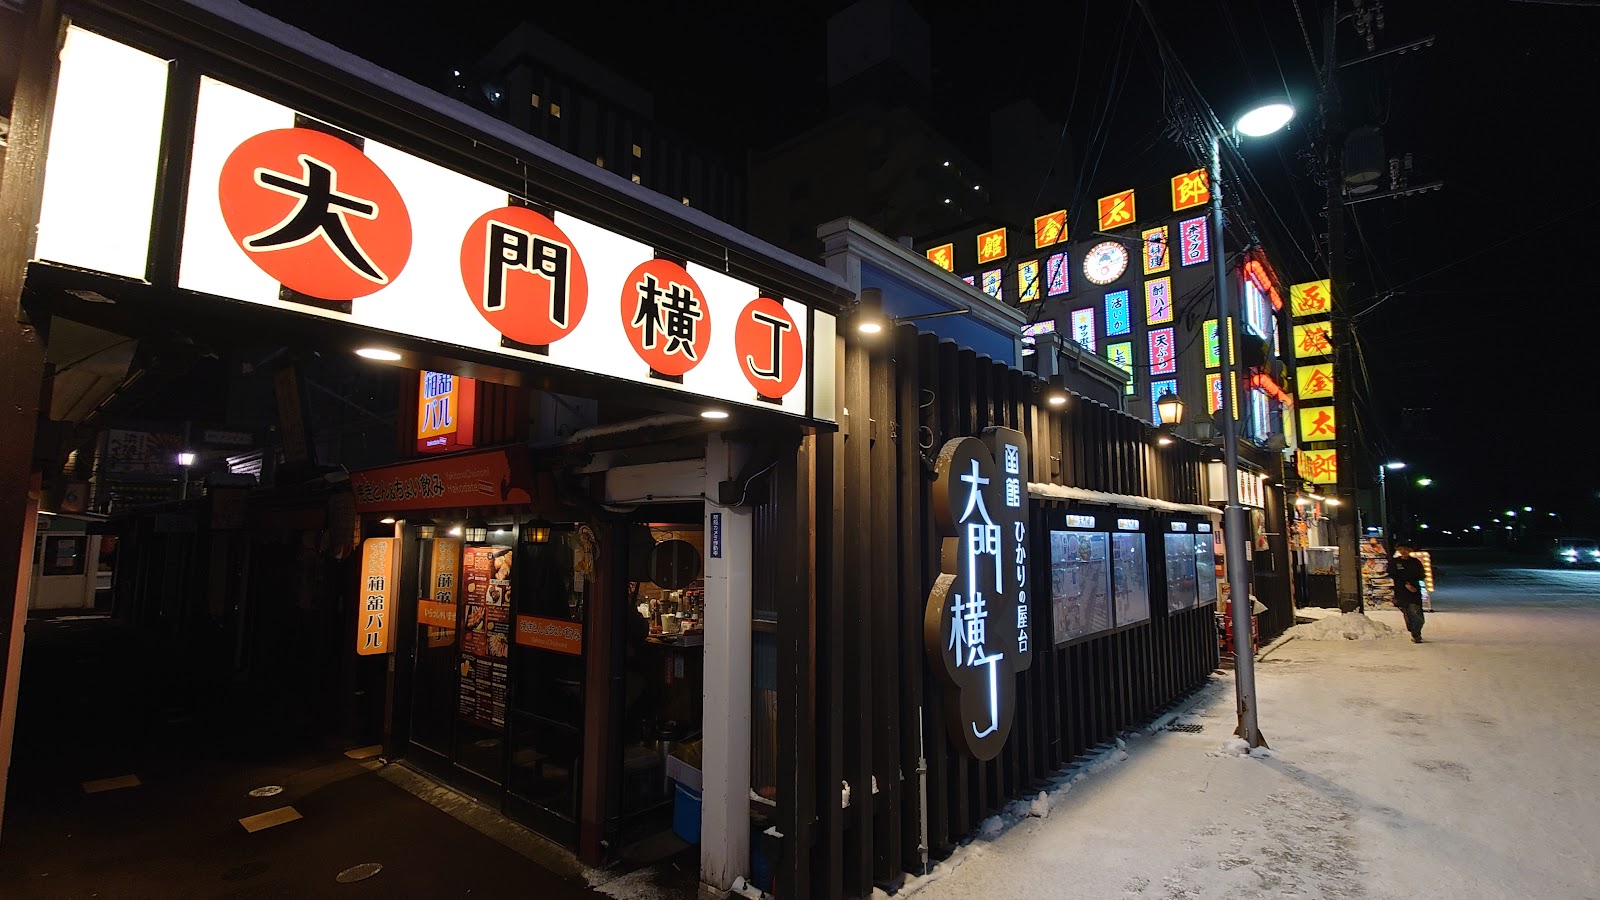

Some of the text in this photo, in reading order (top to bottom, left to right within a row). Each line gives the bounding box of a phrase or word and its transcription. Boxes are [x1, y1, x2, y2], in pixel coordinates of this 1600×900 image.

[933, 170, 1207, 270] 函館金太郎
[1187, 223, 1202, 259] 本マグロ
[242, 152, 794, 384] 大門横丁
[1151, 285, 1165, 319] 酎ハイ
[1110, 297, 1123, 331] 活いか
[1154, 333, 1168, 371] 天ぷら
[1297, 285, 1337, 482] 函館金太郎
[421, 397, 453, 433] バル
[1004, 443, 1028, 654] 函館 ひかりの屋台
[363, 575, 386, 650] 箱舘バル
[948, 457, 1004, 739] 大門横丁
